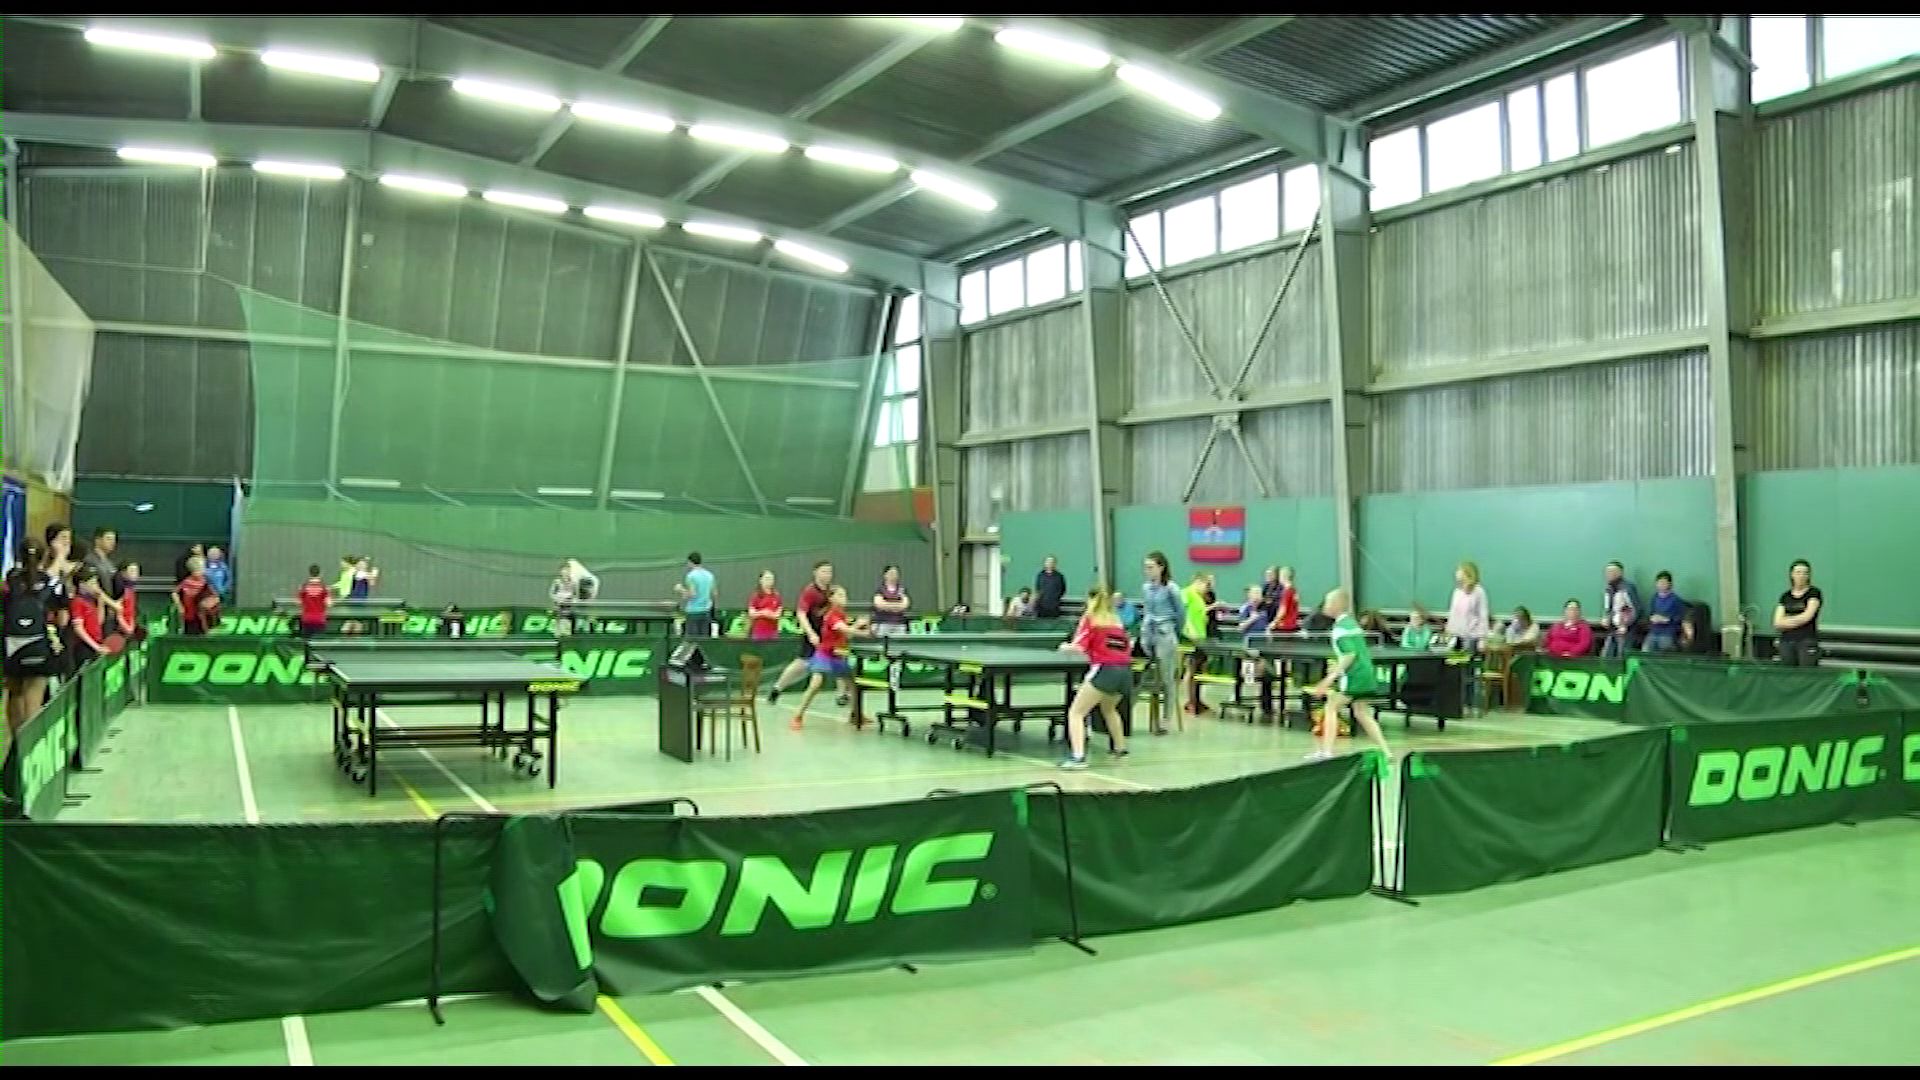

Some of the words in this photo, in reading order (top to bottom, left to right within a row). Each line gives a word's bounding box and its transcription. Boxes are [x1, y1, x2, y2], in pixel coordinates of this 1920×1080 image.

[161, 653, 330, 684] DON
[561, 650, 652, 678] NIC
[1530, 669, 1624, 702] DON
[1688, 735, 1885, 807] DONIC
